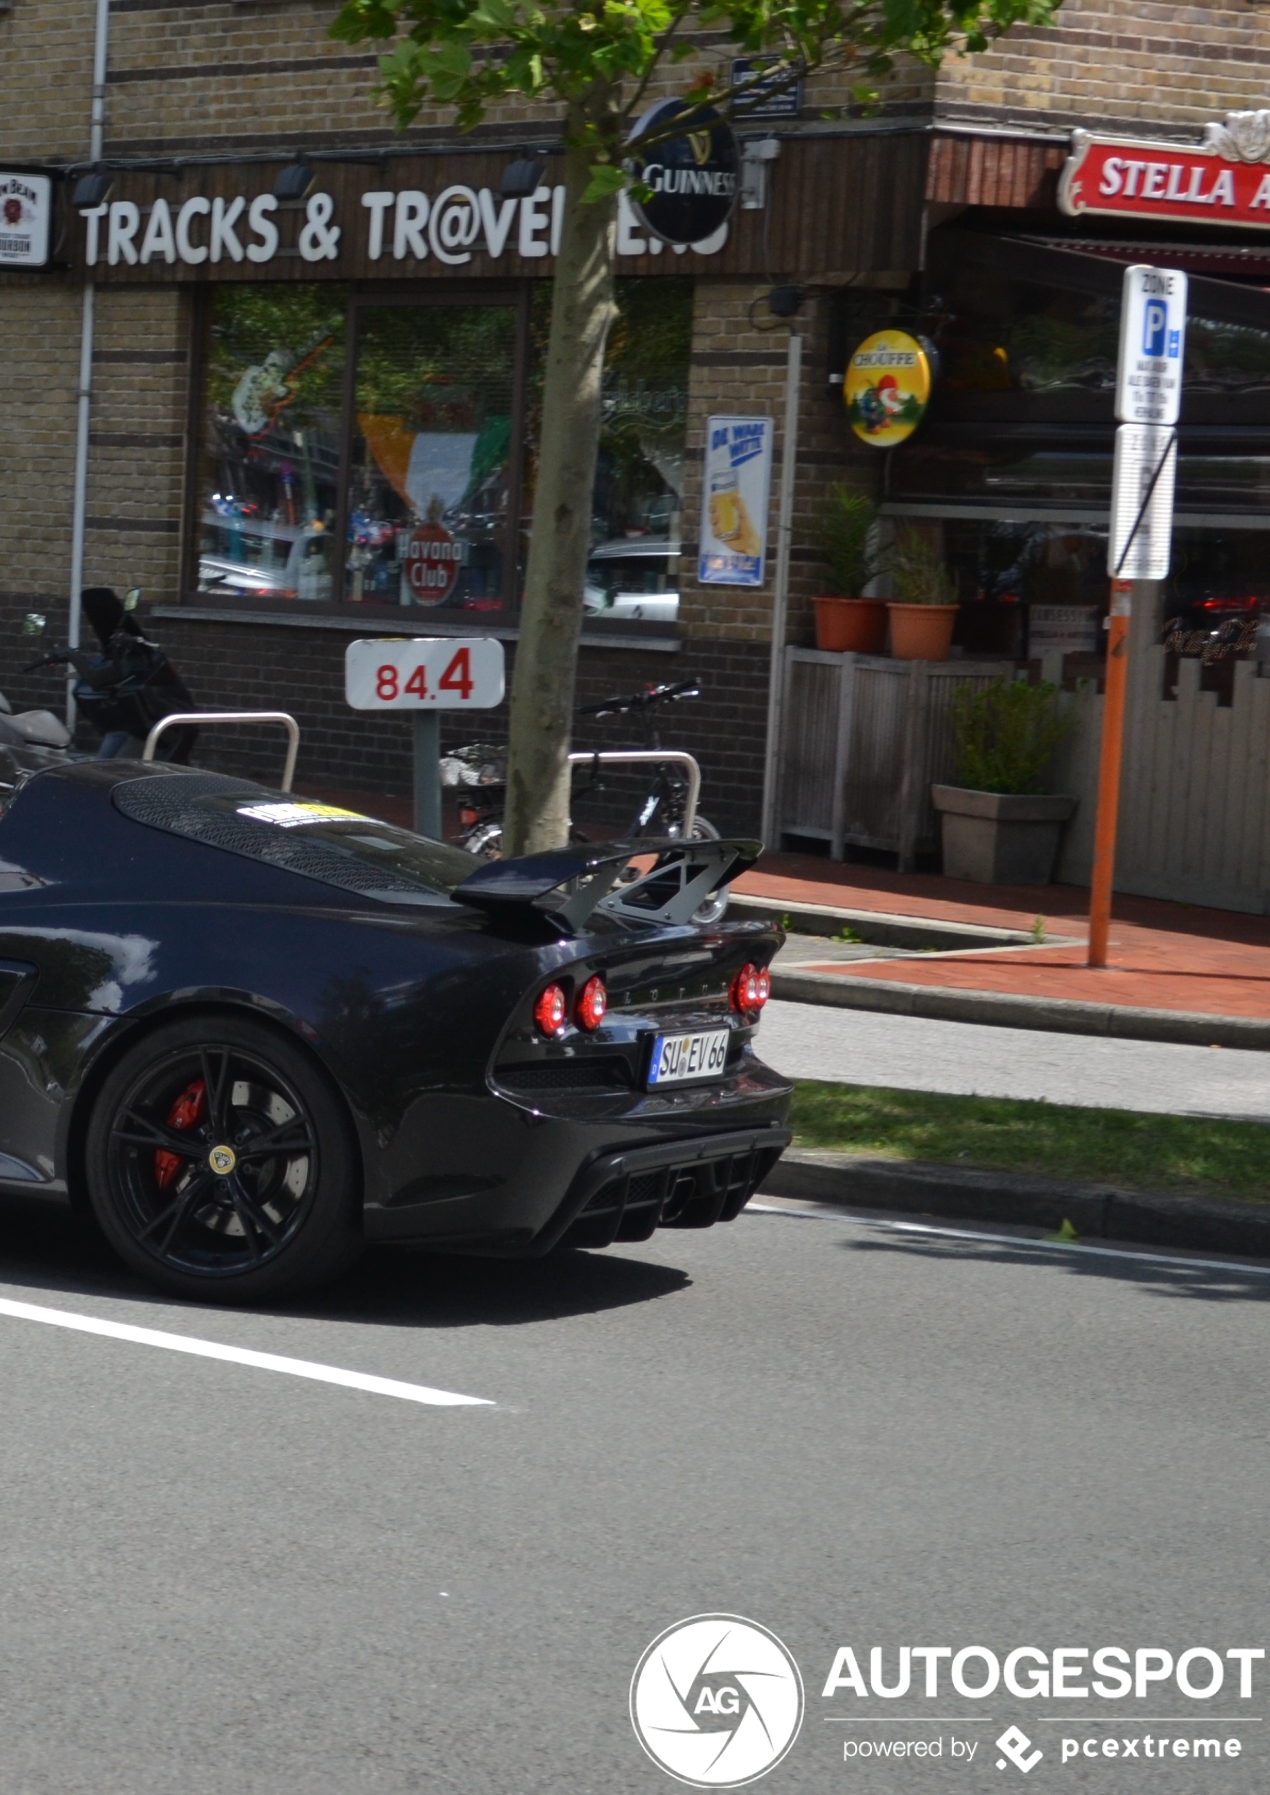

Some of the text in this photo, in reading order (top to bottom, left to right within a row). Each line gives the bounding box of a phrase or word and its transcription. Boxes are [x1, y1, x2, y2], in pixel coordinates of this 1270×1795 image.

[641, 163, 737, 196] GUINNESS
[1099, 157, 1236, 206] STELLA
[78, 193, 279, 267] TRACKS
[298, 192, 342, 262] &
[1141, 273, 1175, 296] ZONE
[854, 352, 916, 367] CHOUFFE
[398, 533, 463, 561] Havana
[410, 562, 448, 588] Club
[375, 647, 475, 701] 84.4
[659, 1039, 683, 1077] SU
[687, 1035, 710, 1073] EV
[708, 1033, 726, 1069] 66
